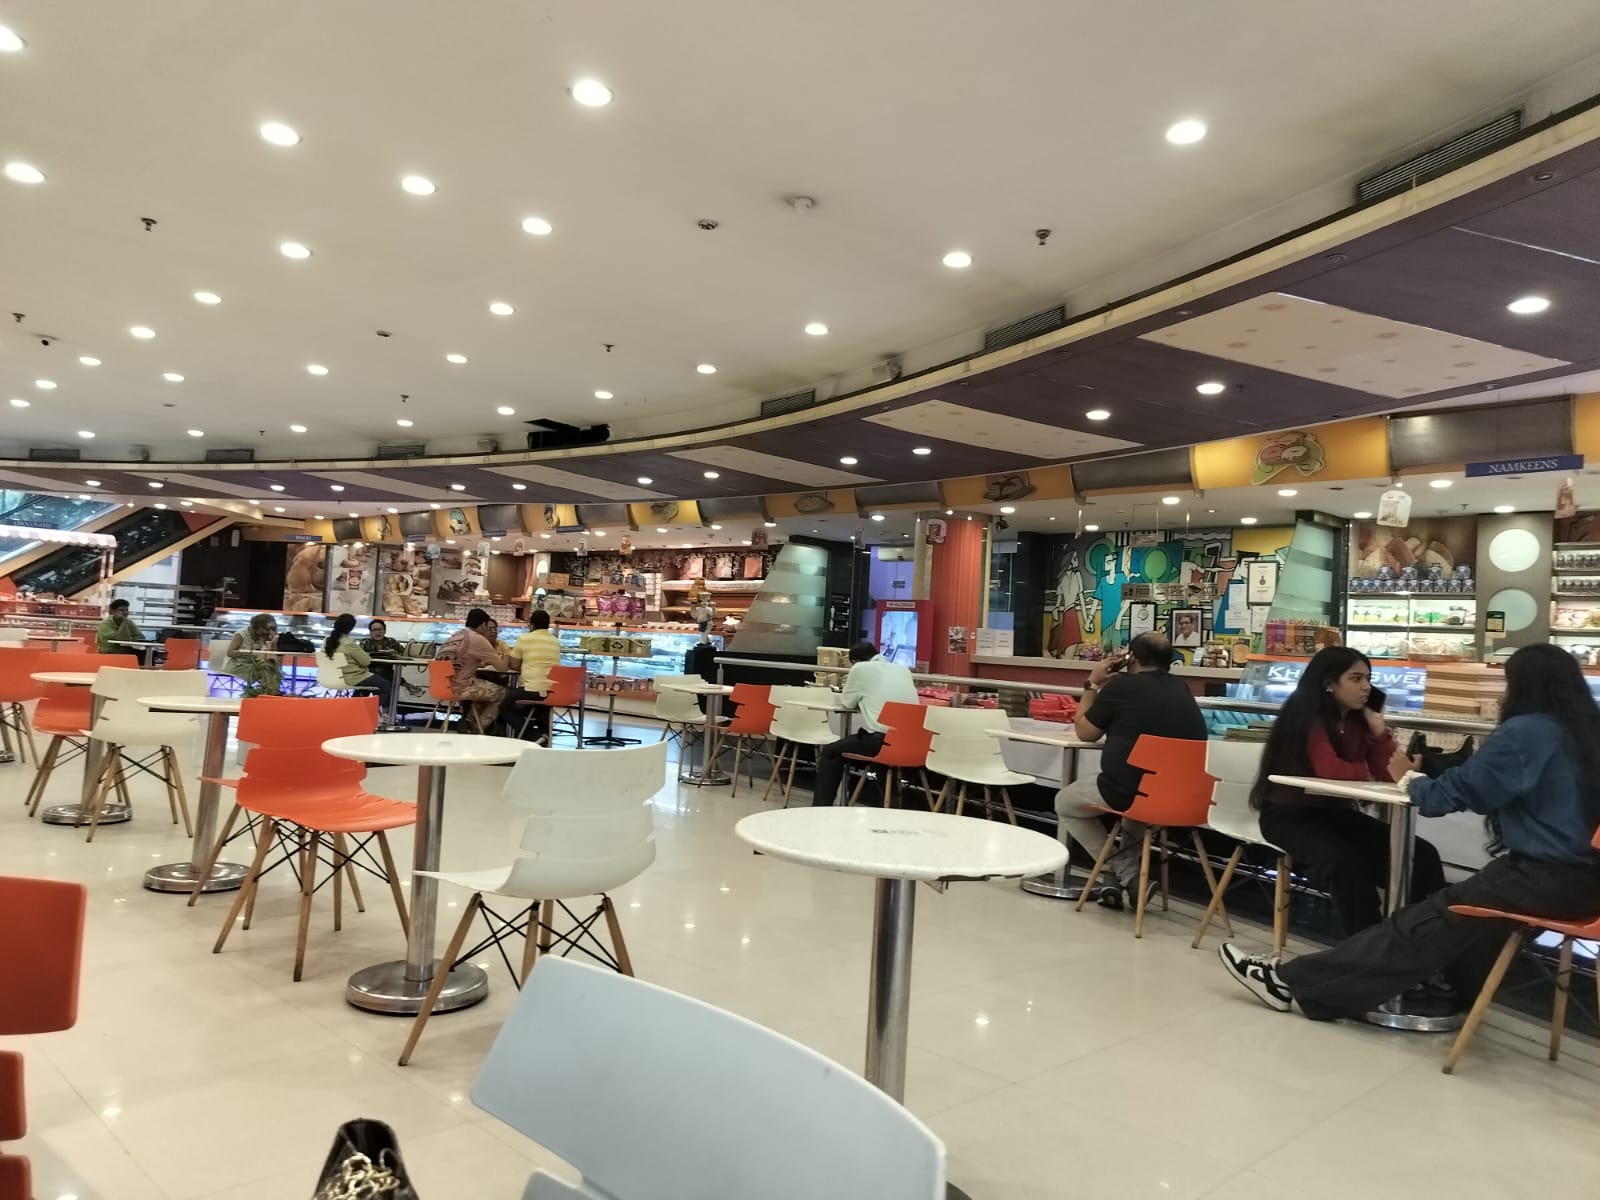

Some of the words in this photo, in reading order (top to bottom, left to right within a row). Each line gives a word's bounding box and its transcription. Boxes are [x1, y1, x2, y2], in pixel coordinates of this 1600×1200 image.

[1488, 458, 1559, 474] NAMKEENS
[1267, 666, 1301, 678] KH
[1370, 671, 1427, 685] SWEE
